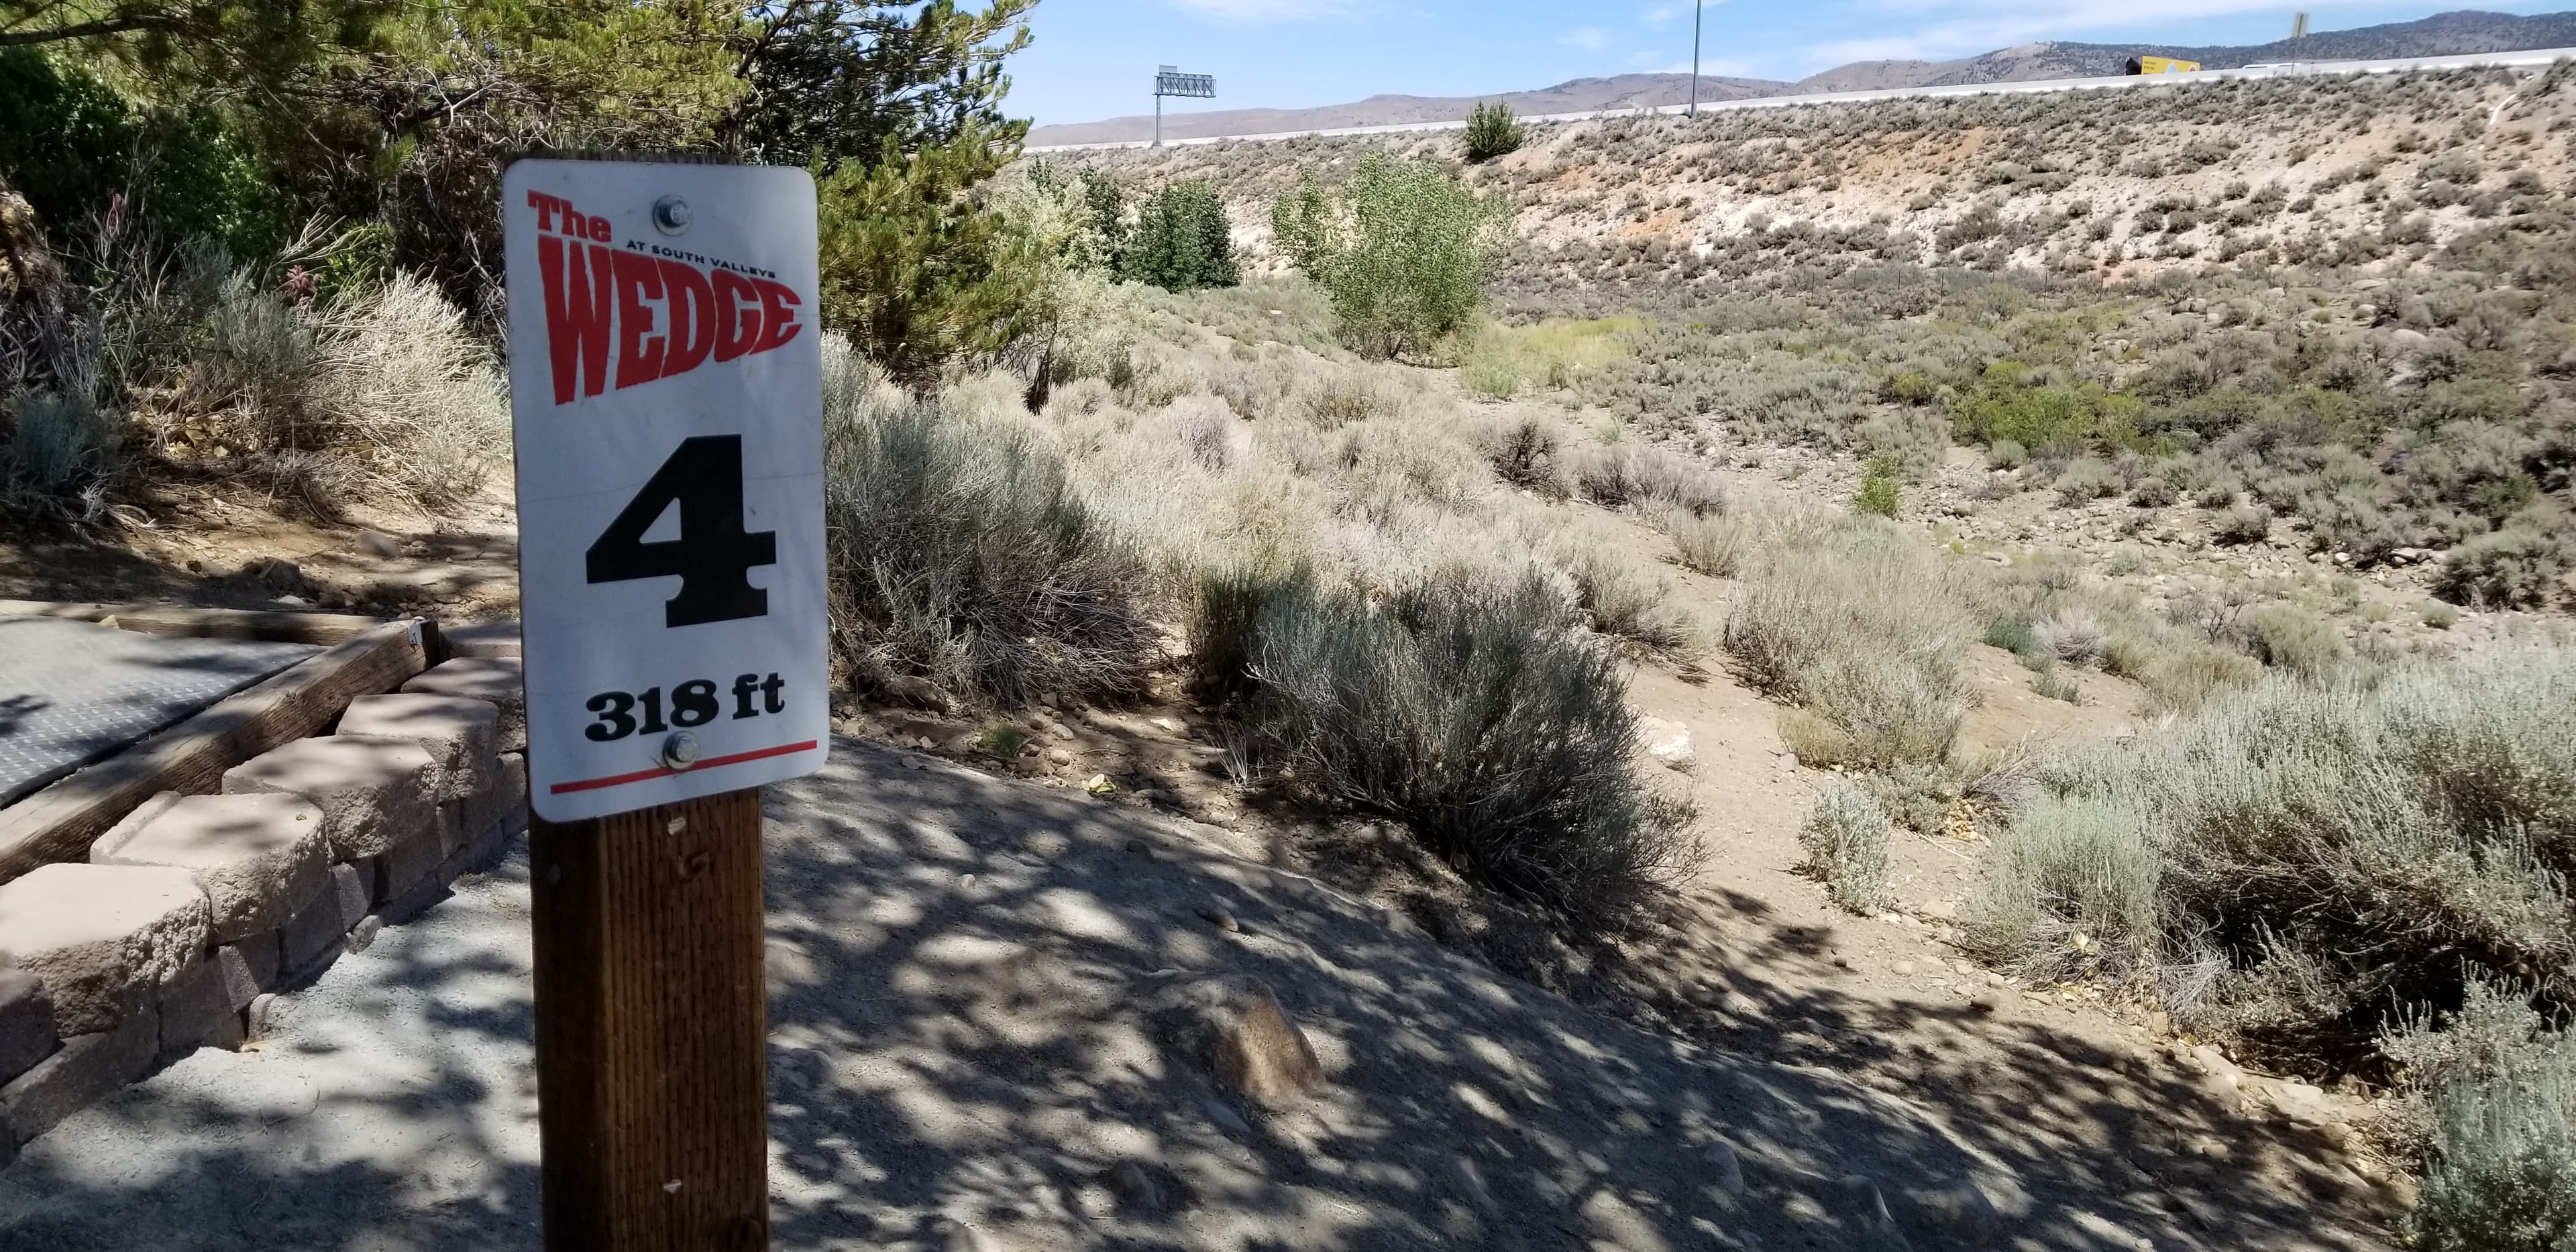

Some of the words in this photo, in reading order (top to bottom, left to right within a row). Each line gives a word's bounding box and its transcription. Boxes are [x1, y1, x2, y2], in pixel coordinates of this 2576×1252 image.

[527, 189, 612, 243] The
[626, 239, 646, 251] AT
[651, 245, 705, 264] SOUTH
[710, 258, 776, 279] VALLEYS
[538, 234, 802, 406] WEDGE
[586, 434, 777, 628] 4
[584, 679, 720, 742] 318
[732, 672, 785, 720] ft
